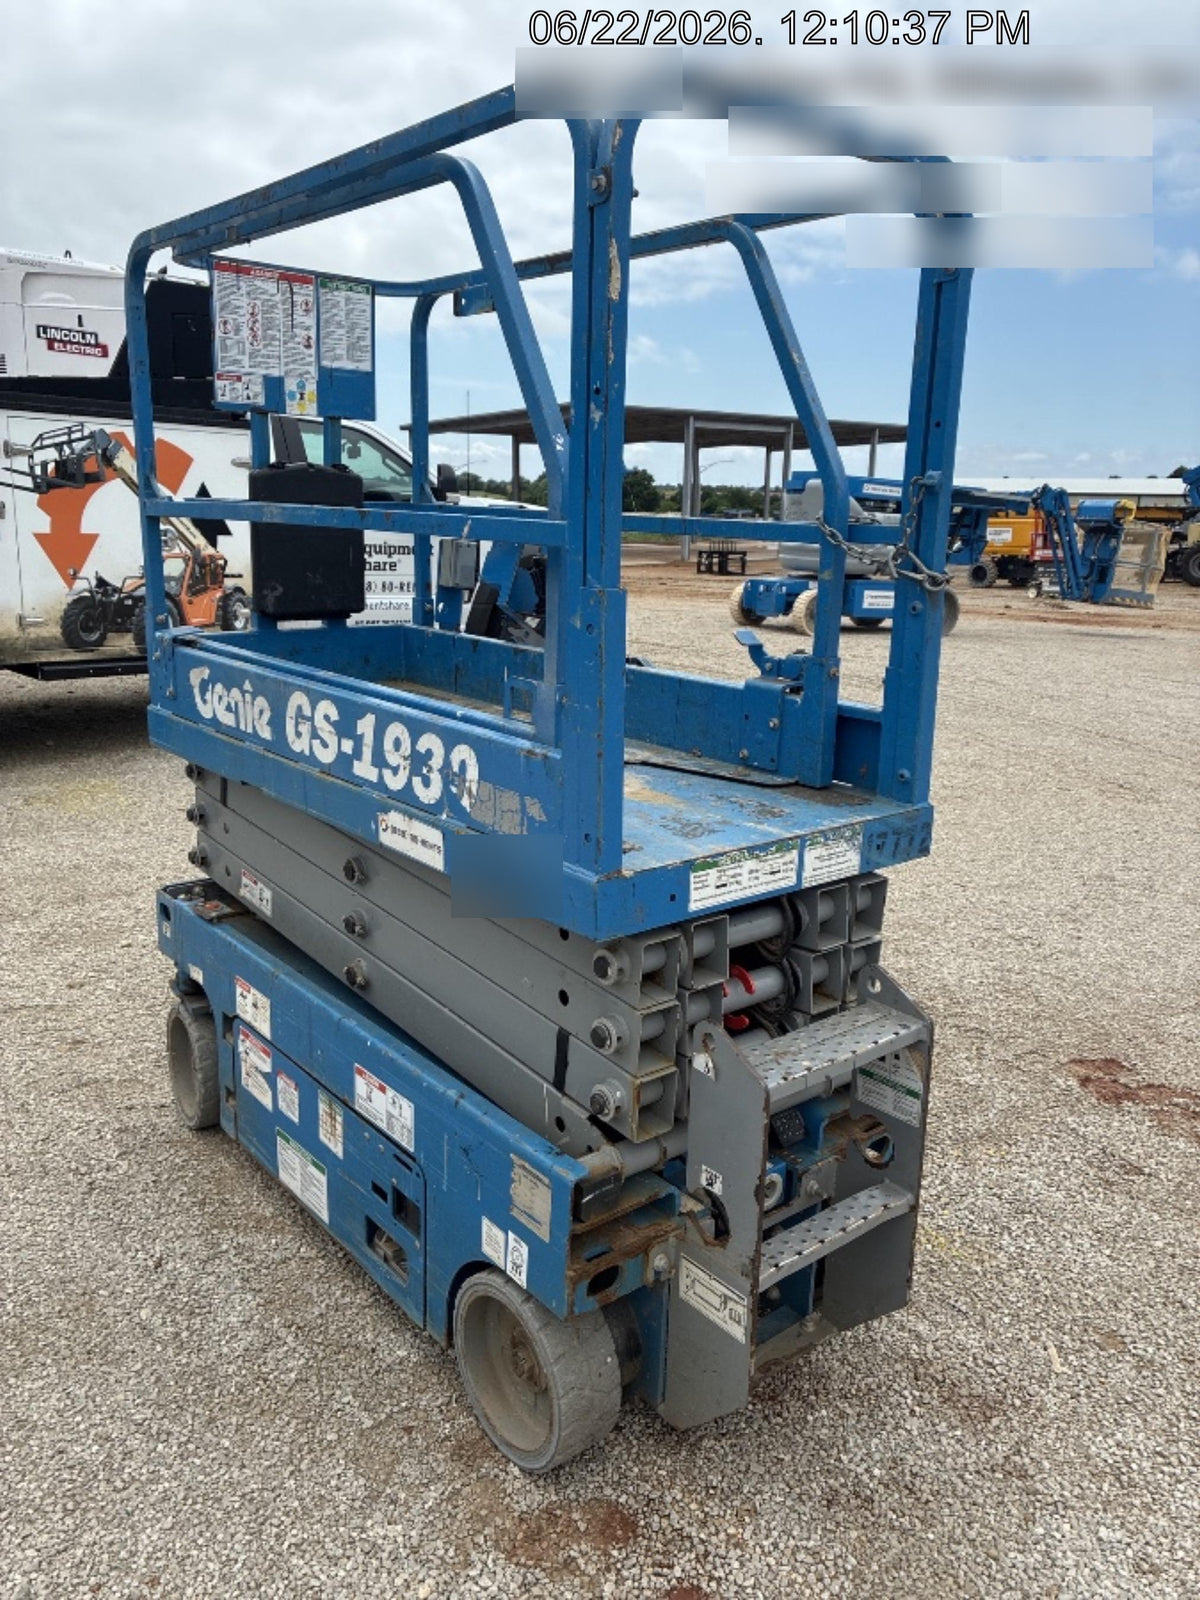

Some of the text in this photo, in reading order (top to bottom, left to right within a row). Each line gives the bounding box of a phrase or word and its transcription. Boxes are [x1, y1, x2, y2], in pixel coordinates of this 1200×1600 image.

[39, 326, 96, 345] LINCOLN
[54, 342, 102, 356] ELECTRIC
[364, 561, 397, 571] hare
[190, 665, 273, 741] Genie
[286, 690, 479, 813] GS-1930
